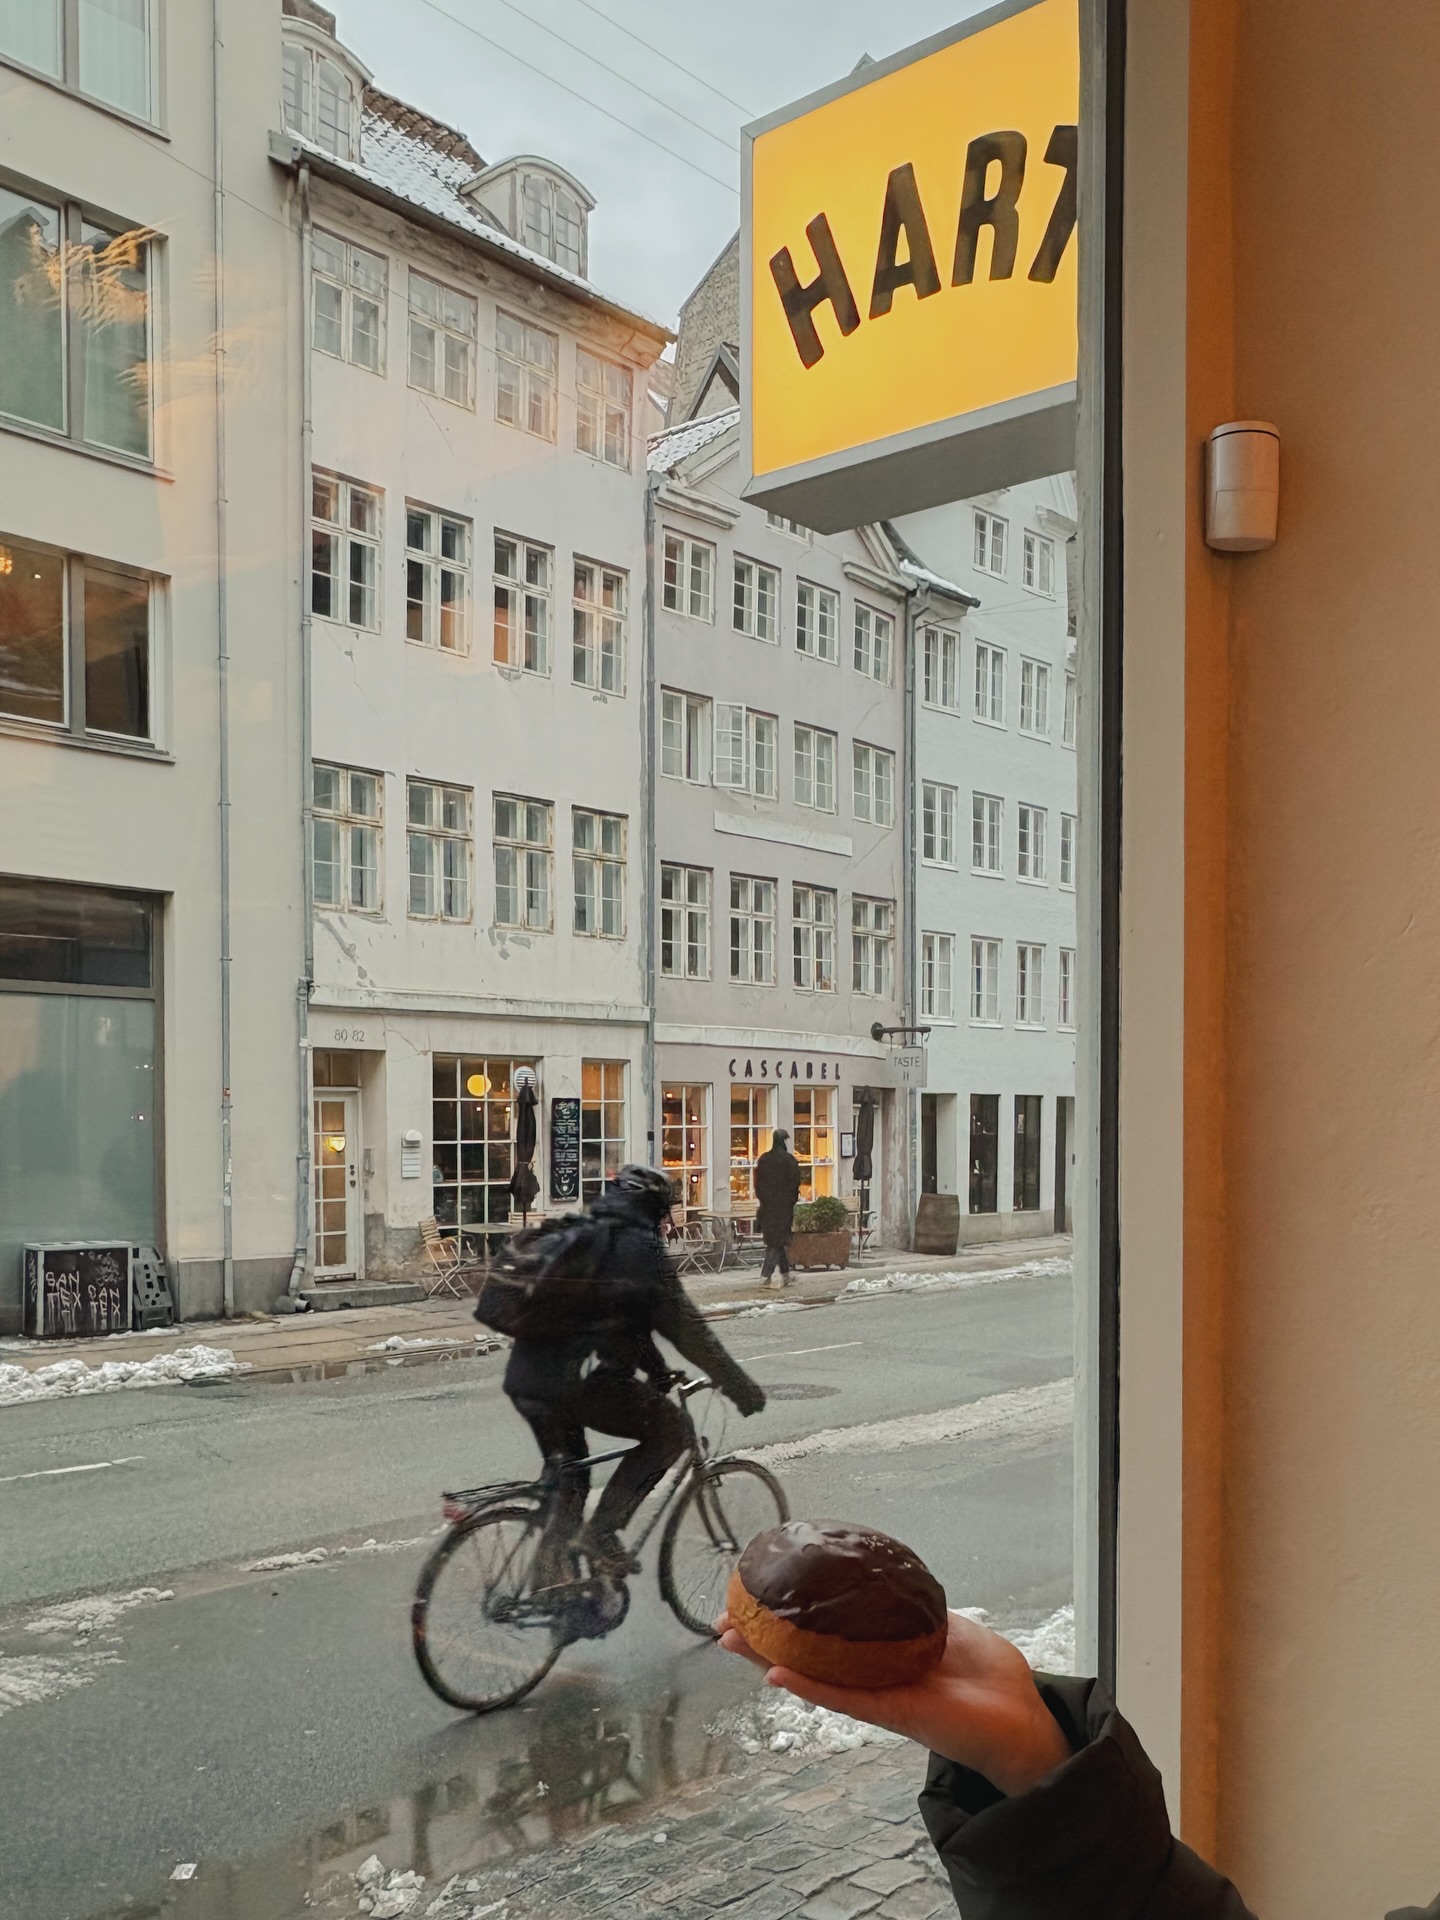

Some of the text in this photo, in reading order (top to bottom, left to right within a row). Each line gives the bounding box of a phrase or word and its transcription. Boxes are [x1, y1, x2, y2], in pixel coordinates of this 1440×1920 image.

[768, 124, 1078, 369] HART
[334, 1029, 365, 1042] 80 82
[728, 1059, 841, 1080] CASCABEL
[894, 1056, 920, 1067] TASTE
